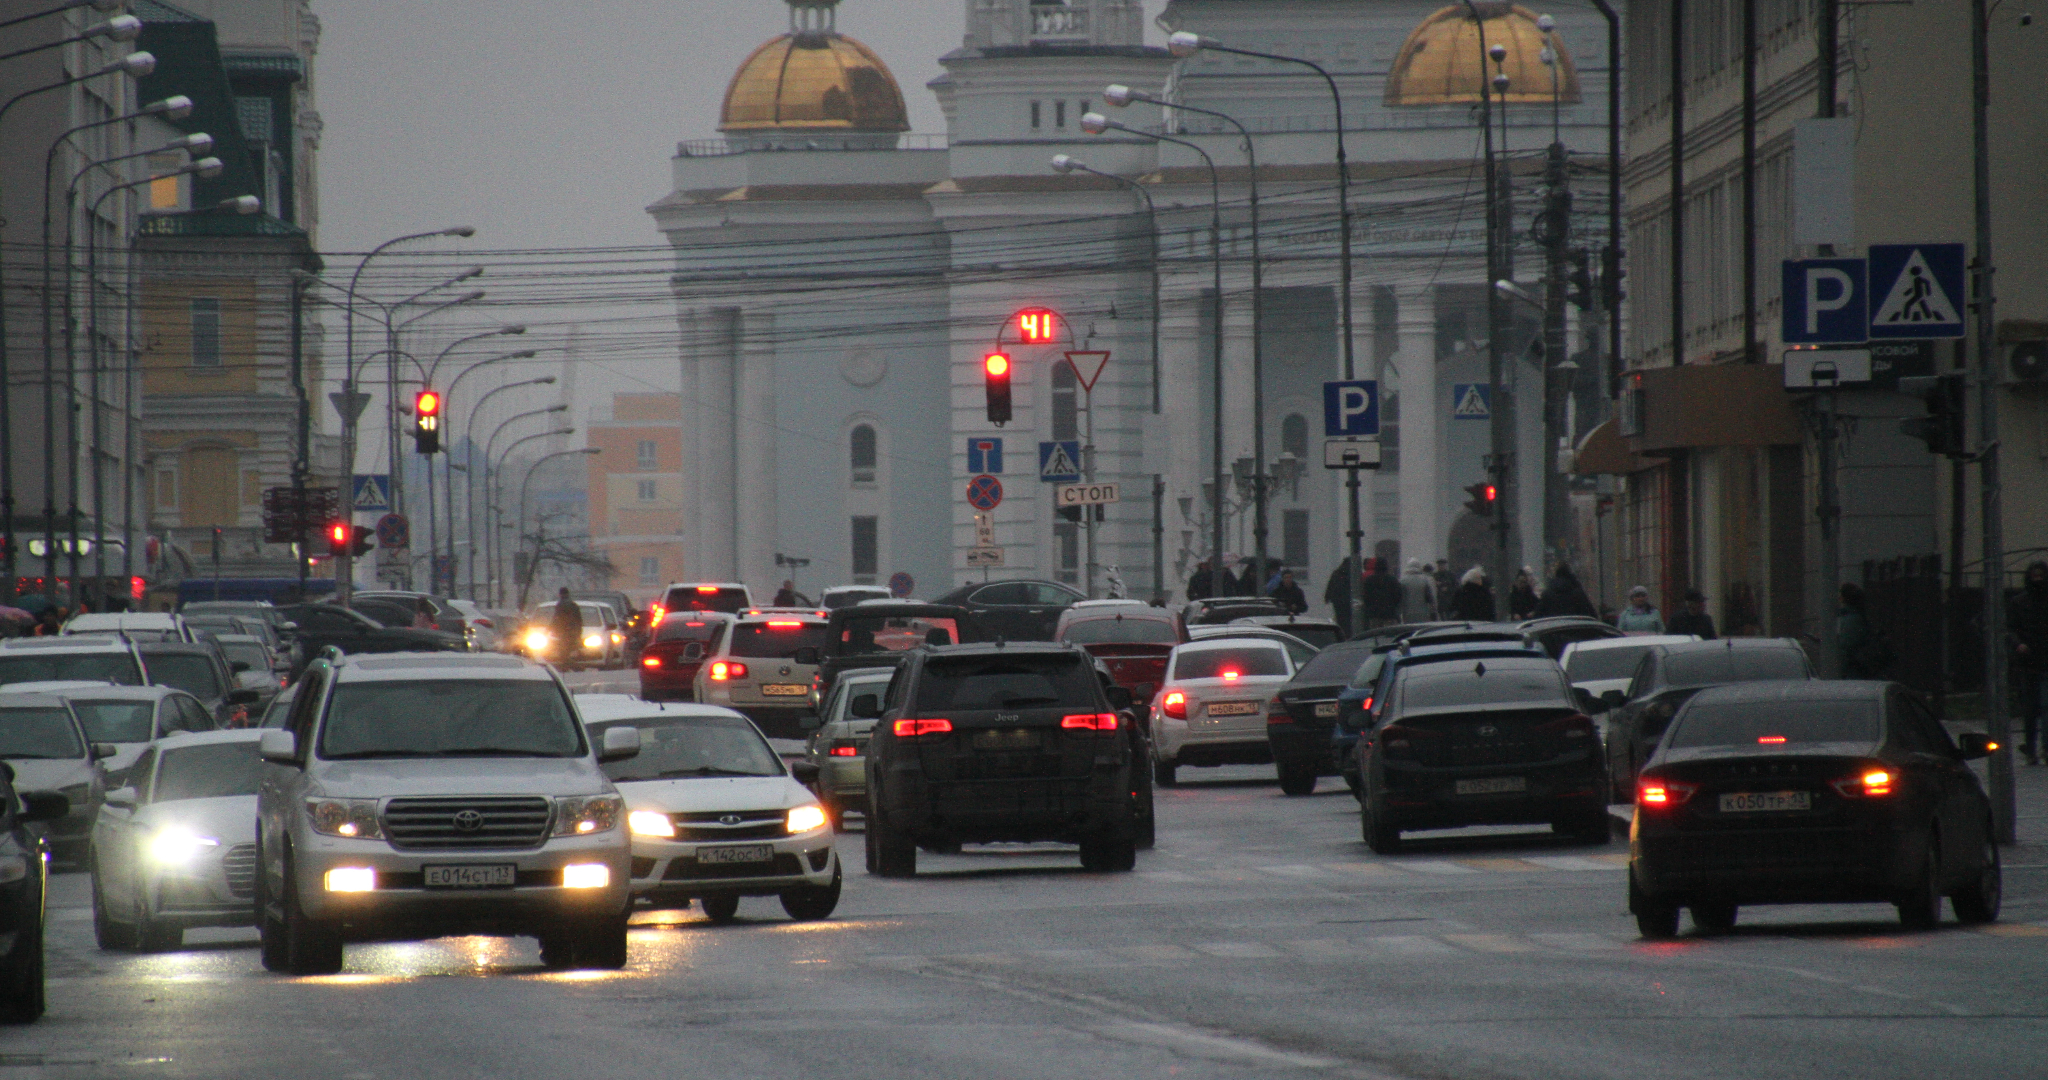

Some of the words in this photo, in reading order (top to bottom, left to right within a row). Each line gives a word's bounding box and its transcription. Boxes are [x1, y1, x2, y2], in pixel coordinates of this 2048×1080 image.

[1806, 267, 1853, 333] P
[1021, 314, 1050, 338] 41
[1339, 386, 1369, 429] P
[1065, 486, 1113, 501] СТОП
[995, 714, 1019, 722] Jeep
